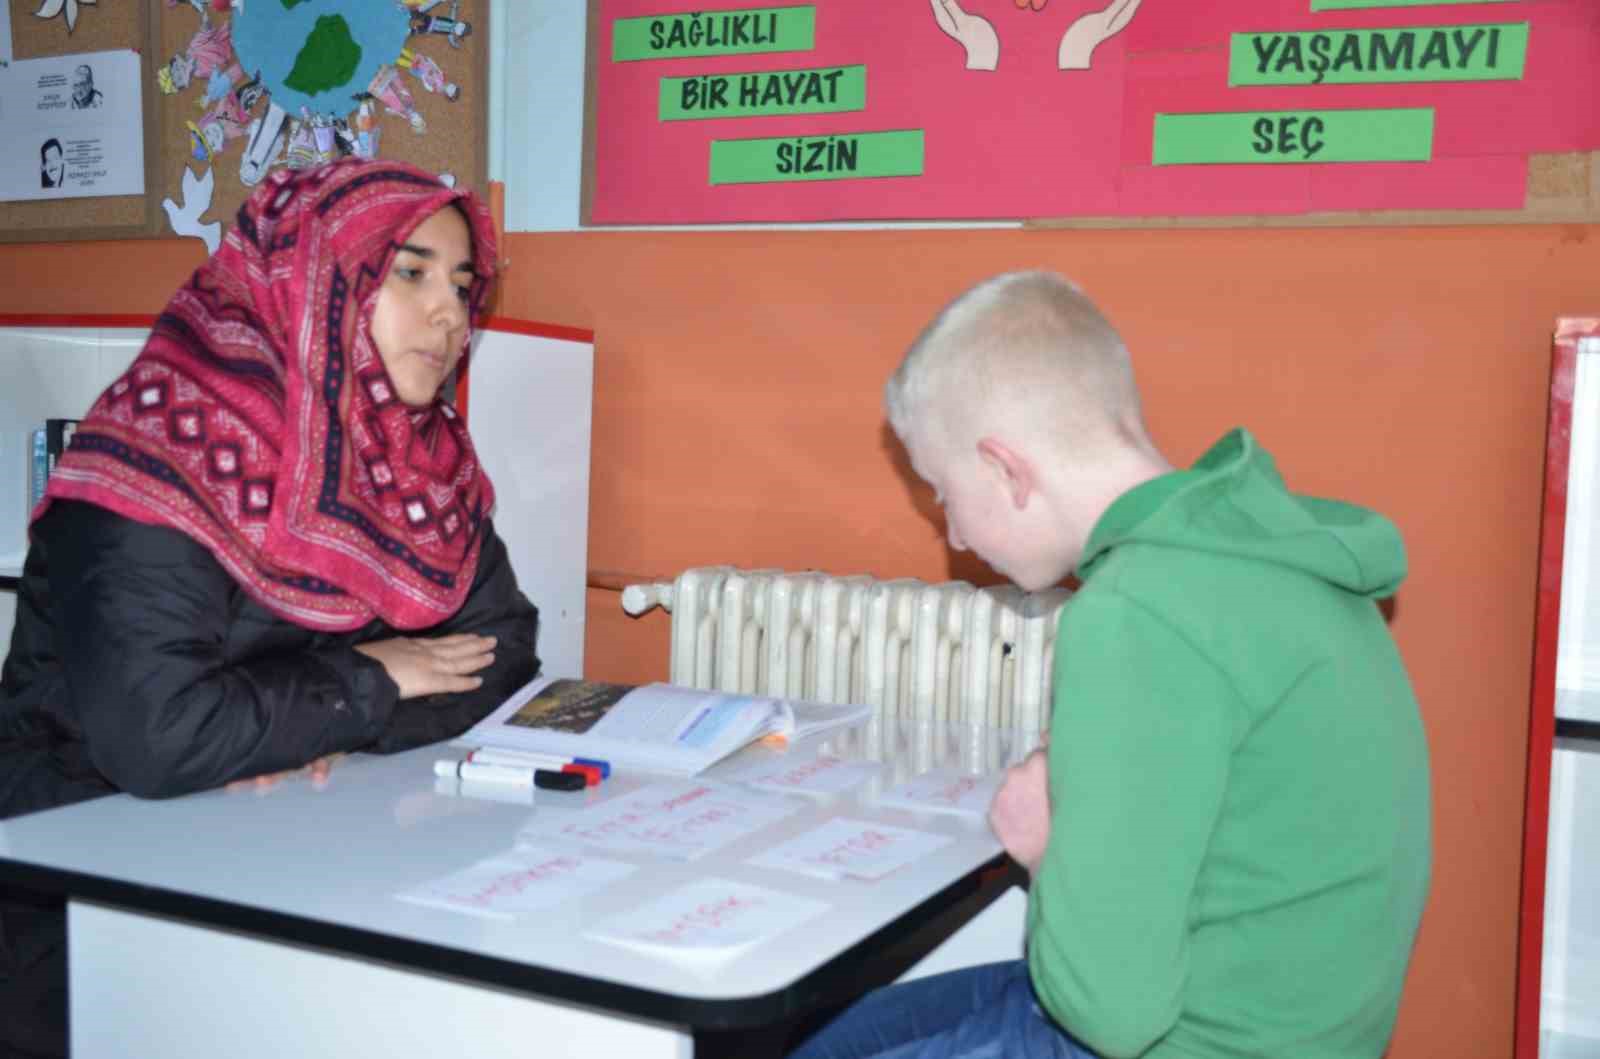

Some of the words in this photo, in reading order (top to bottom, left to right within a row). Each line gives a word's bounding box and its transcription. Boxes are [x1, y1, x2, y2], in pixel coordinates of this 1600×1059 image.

[650, 11, 777, 50] SAĞLIKLI
[1252, 28, 1500, 83] YAŞAMAYI
[681, 75, 729, 111] BİR
[739, 69, 843, 107] HAYAT
[776, 136, 858, 174] SİZİN
[1252, 117, 1324, 158] SEÇ
